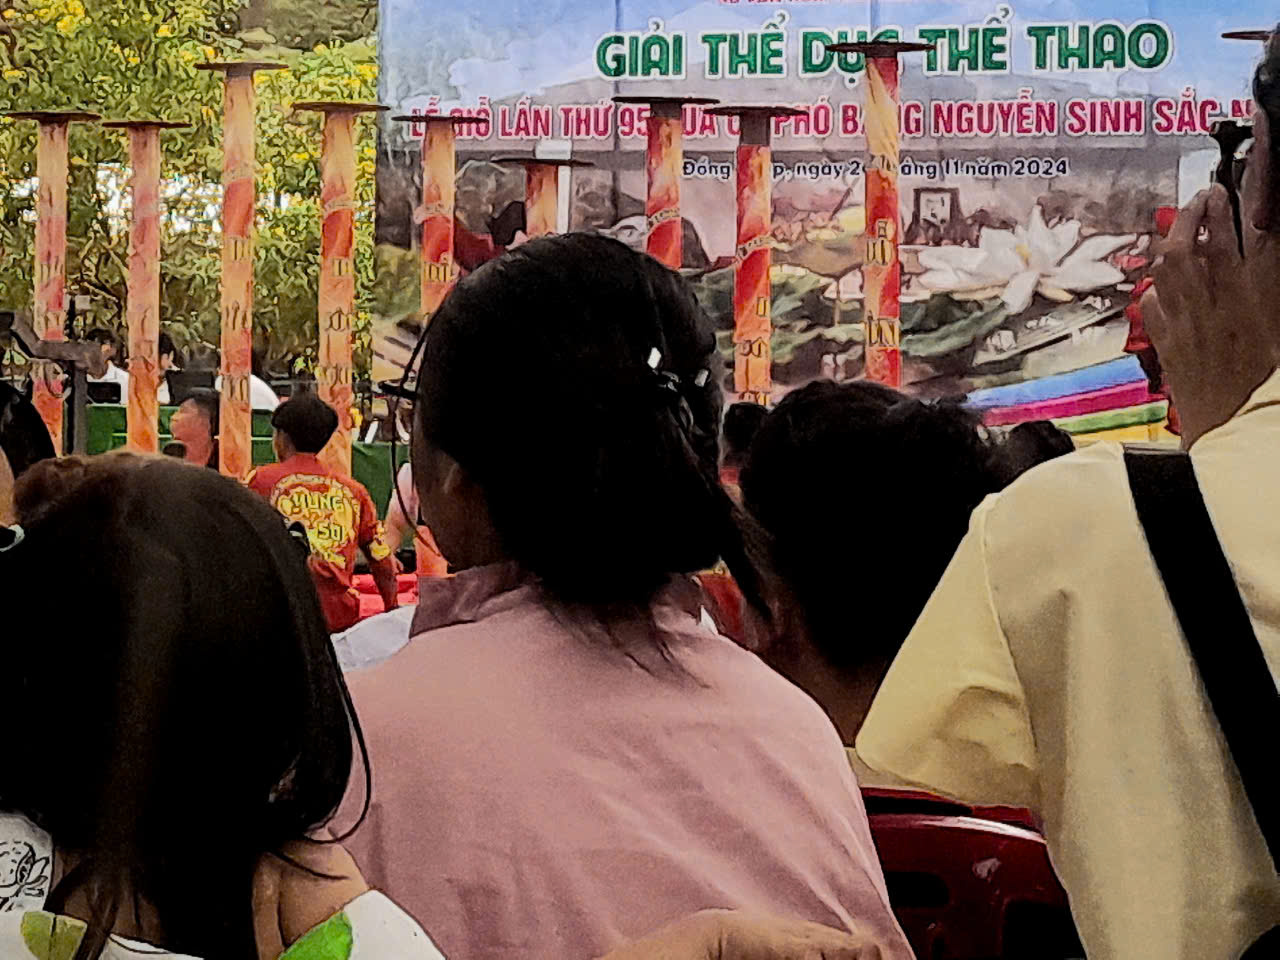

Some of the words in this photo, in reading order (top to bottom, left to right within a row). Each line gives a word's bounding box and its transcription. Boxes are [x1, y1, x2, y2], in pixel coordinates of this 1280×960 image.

[596, 21, 683, 76] GIẢI
[702, 13, 784, 75] THỂ
[920, 7, 1007, 71] THỂ
[1027, 23, 1169, 69] THAO
[933, 90, 1056, 134] NGUYỄN
[1068, 100, 1143, 134] SINH
[1154, 86, 1218, 133] SẮC
[965, 157, 1008, 176] năm
[1014, 159, 1067, 176] 2024
